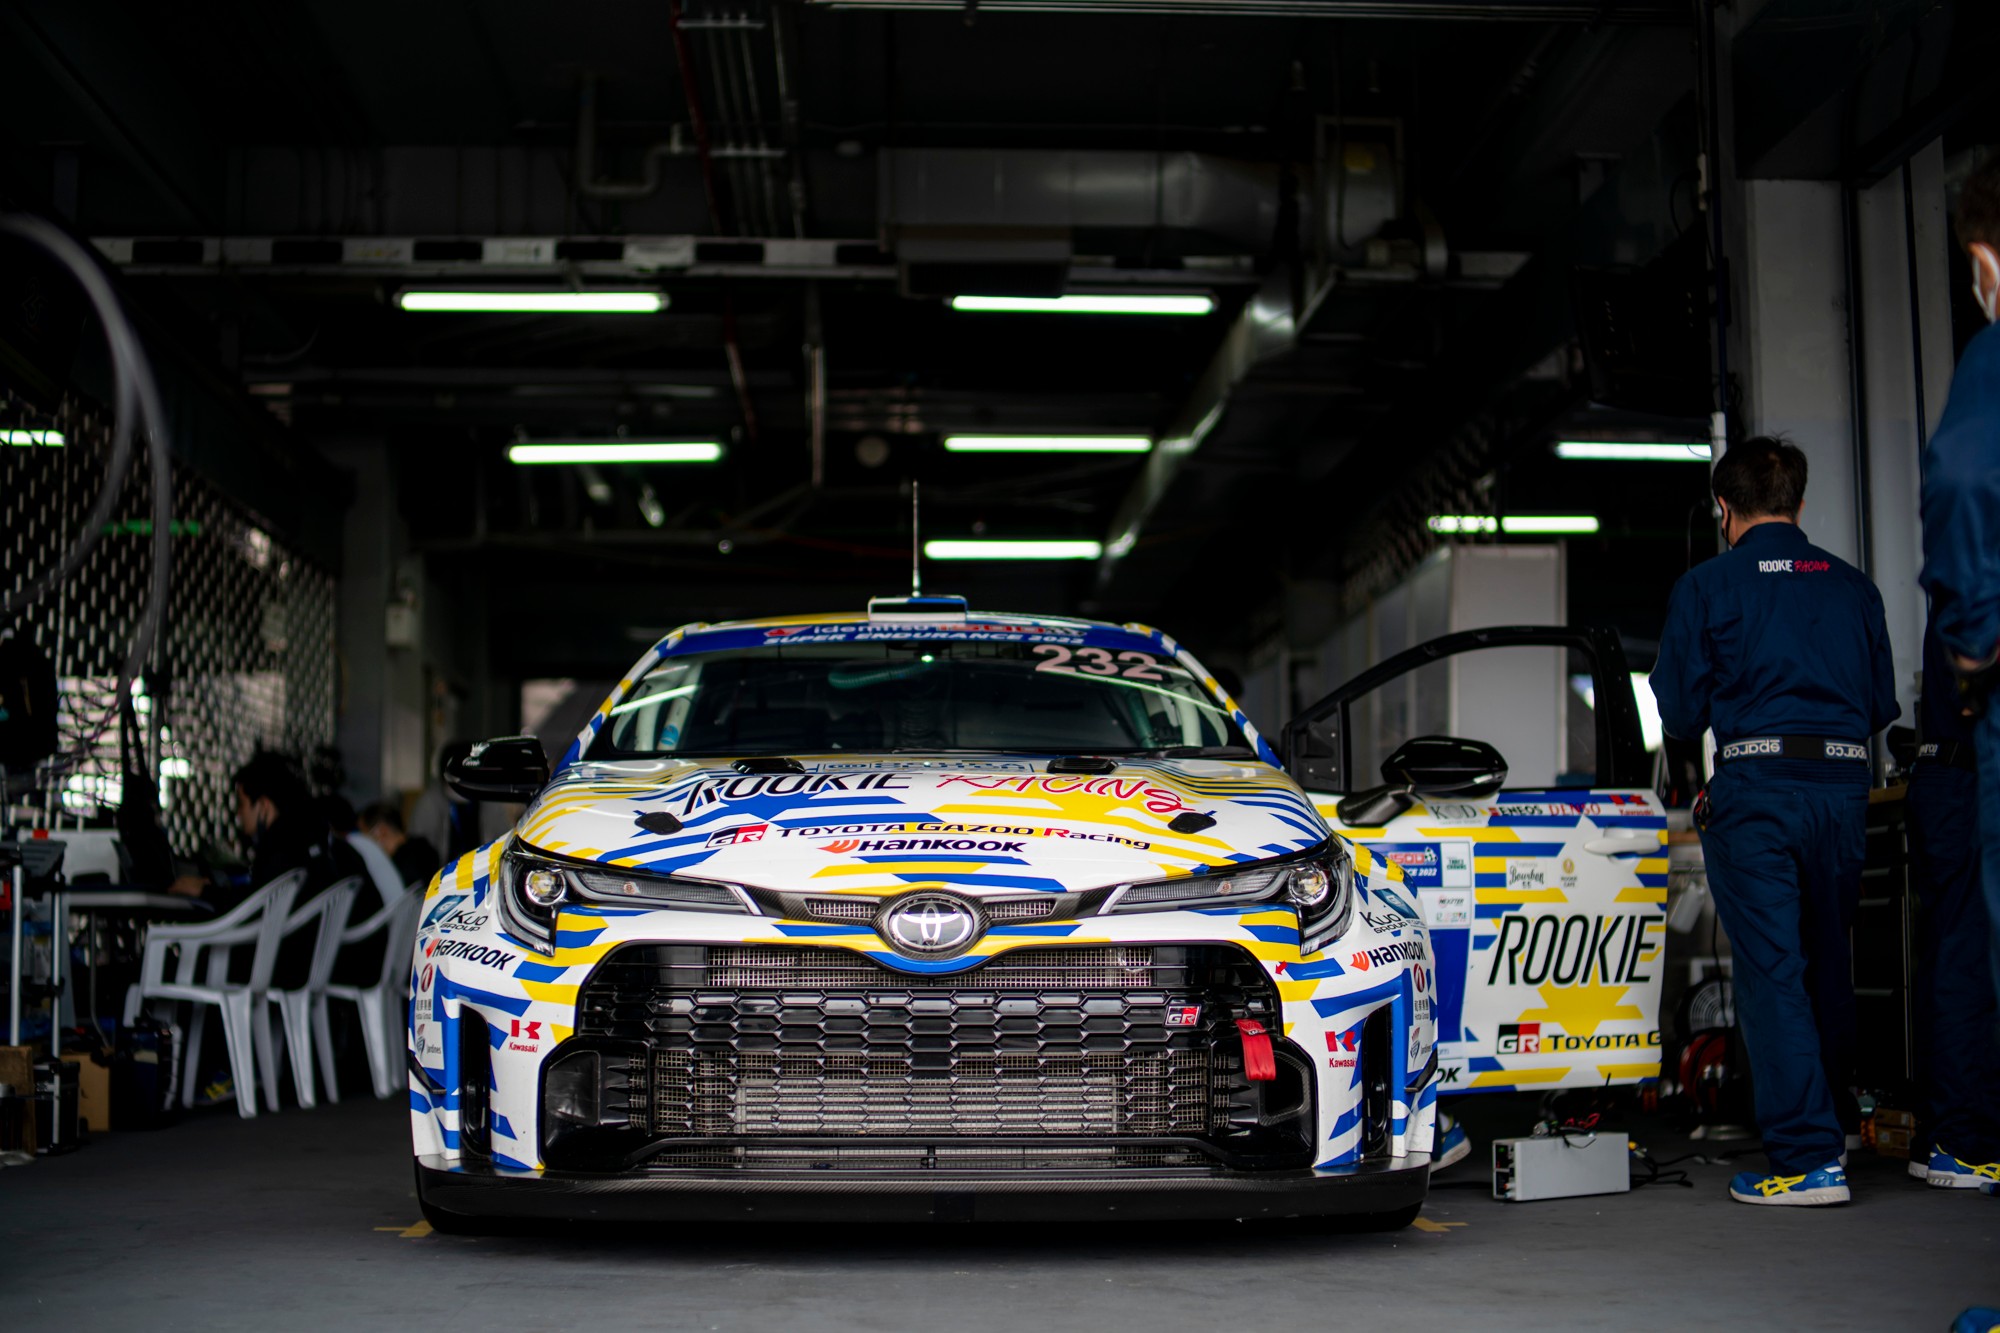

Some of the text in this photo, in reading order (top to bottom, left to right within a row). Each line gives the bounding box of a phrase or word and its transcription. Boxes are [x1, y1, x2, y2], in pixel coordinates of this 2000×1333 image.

[1759, 559, 1793, 572] ROOKIE
[814, 624, 930, 634] idemitsu
[763, 632, 1085, 645] SUPER ENDURANCE 2022
[1033, 644, 1163, 681] 232
[683, 773, 913, 816] ROOKIE
[1499, 803, 1601, 816] ENEOS DENSO
[707, 821, 1151, 850] GR TOYOTA GAZOO Racing
[1419, 868, 1438, 877] 2022
[439, 923, 481, 932] GROUP
[1373, 921, 1408, 934] GROUP
[1487, 914, 1664, 986] ROOKIE
[1167, 1013, 1196, 1024] GR
[508, 1041, 539, 1053] Kawasaki
[1497, 1033, 1540, 1054] GR
[1548, 1033, 1640, 1050] TOYOTA
